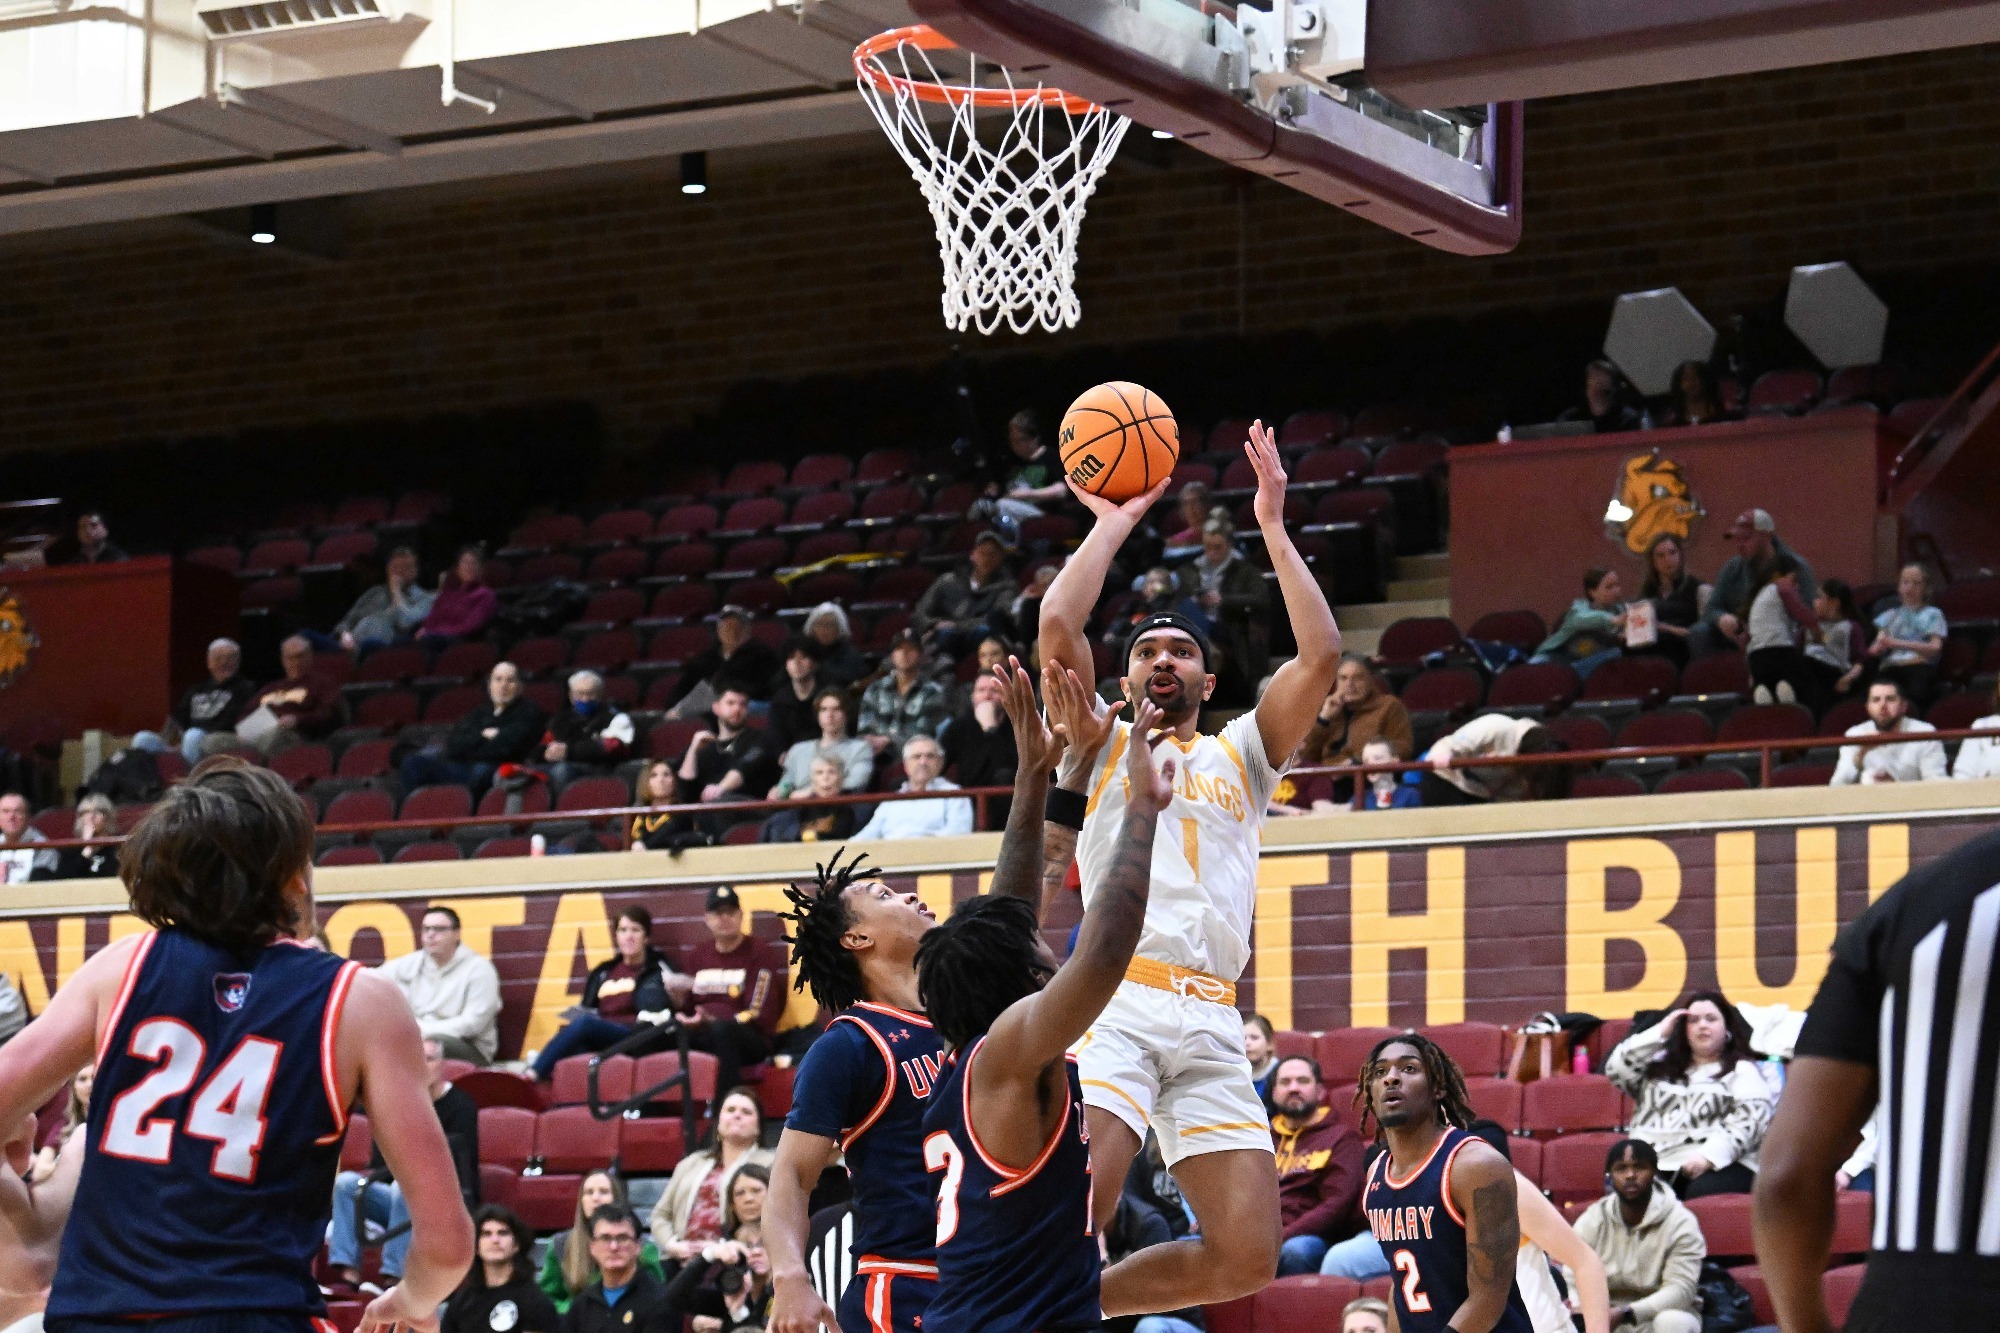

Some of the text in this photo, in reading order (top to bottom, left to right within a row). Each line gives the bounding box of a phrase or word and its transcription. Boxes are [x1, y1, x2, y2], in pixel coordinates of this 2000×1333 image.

[1178, 817, 1200, 883] 1
[98, 1014, 284, 1184] 24
[1368, 1206, 1434, 1242] UMARY
[1393, 1249, 1433, 1313] 2
